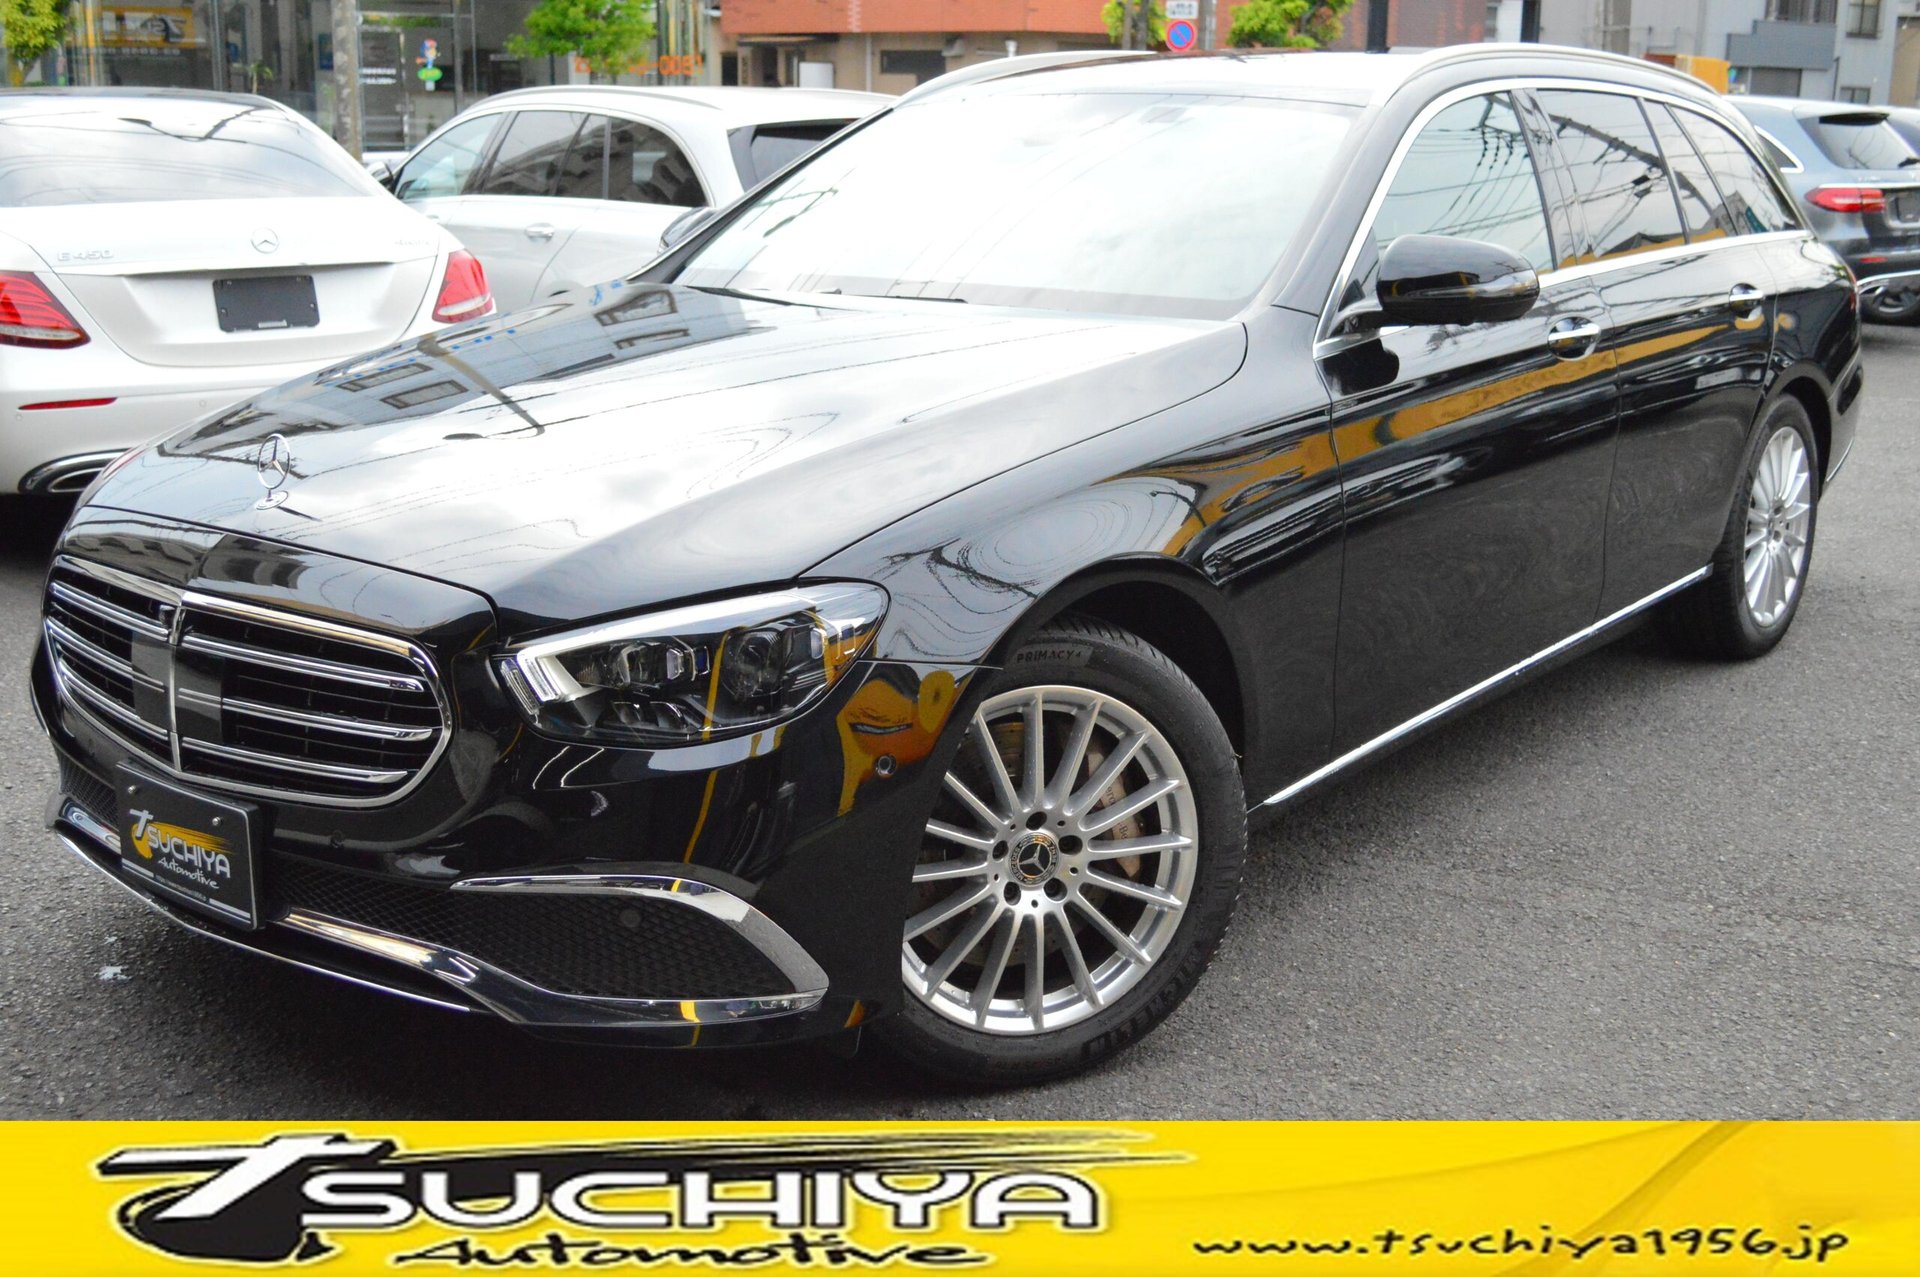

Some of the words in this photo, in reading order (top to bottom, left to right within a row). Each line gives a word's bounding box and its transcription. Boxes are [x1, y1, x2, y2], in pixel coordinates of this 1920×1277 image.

[1016, 649, 1075, 664] PRIMACY
[129, 809, 231, 879] TSUCHIYA
[158, 857, 219, 889] Automotive
